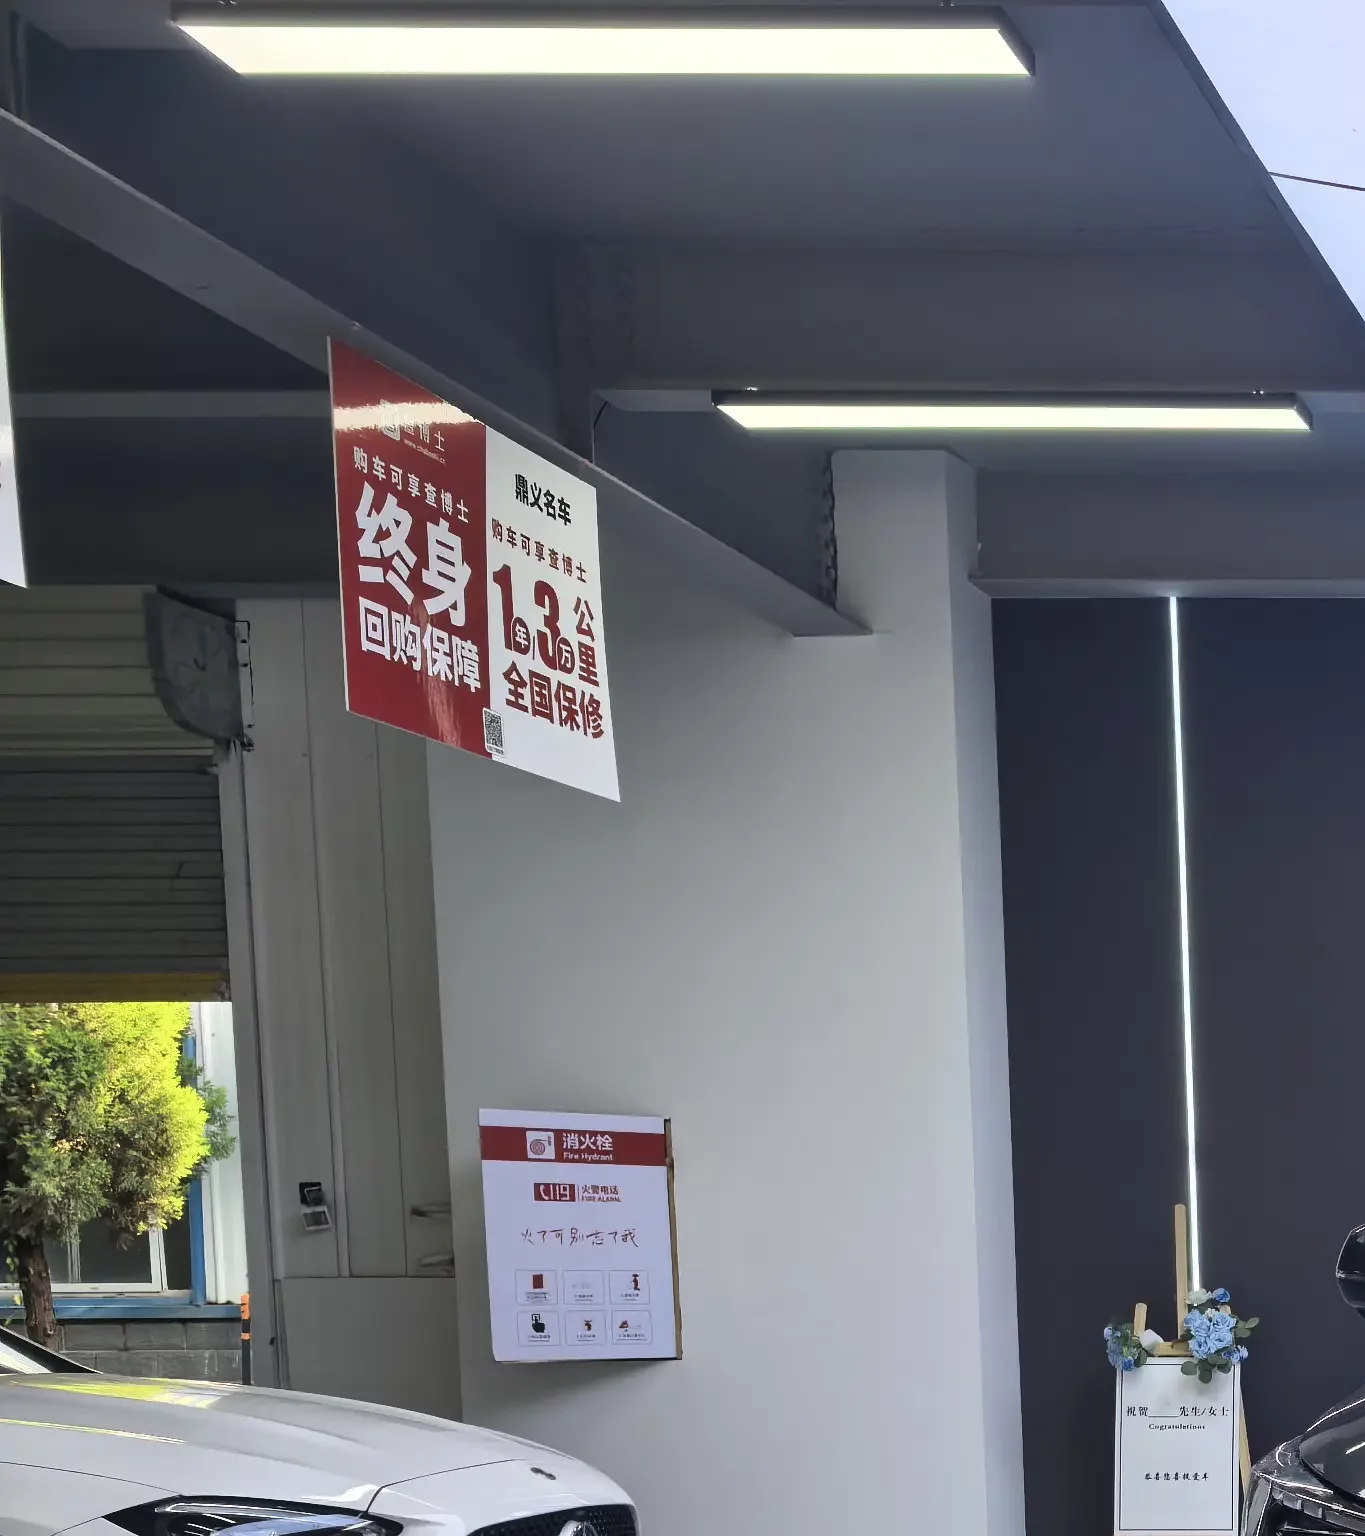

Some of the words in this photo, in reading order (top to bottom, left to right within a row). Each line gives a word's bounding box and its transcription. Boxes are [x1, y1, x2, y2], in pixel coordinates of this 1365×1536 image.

[352, 445, 470, 525] 购车可享查博士
[515, 473, 572, 526] 鼎义名车
[355, 481, 472, 627] 终身
[491, 517, 588, 584] 购车可享查博士
[357, 595, 483, 692] 回购保障
[502, 658, 605, 740] 全国保修
[562, 1131, 614, 1152] 消火栓
[563, 1151, 580, 1161] Fire
[550, 1184, 570, 1201] 119
